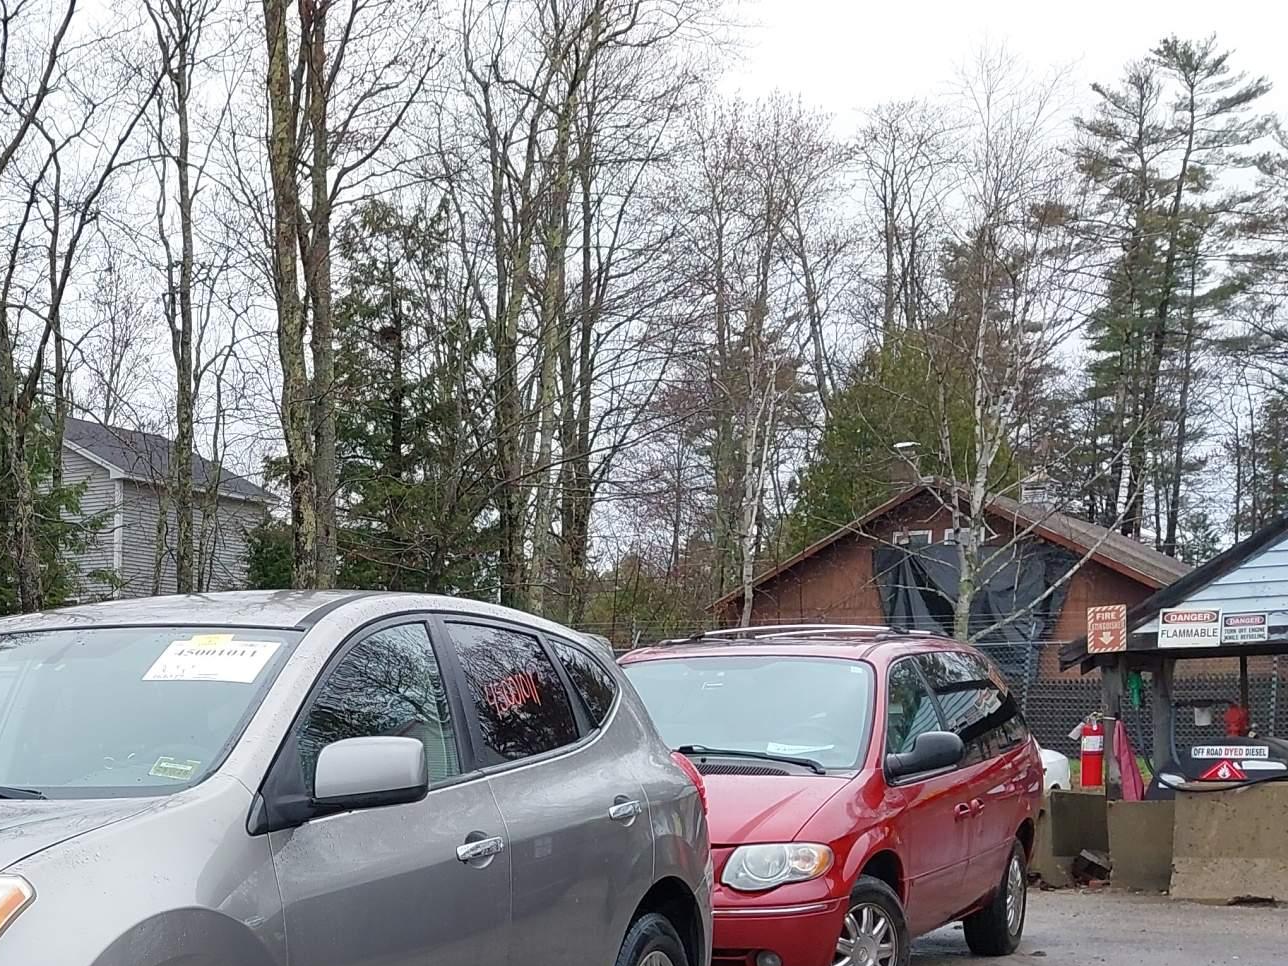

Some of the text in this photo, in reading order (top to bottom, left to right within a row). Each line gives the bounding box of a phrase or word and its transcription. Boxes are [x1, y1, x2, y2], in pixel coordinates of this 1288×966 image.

[1096, 611, 1117, 620] FIRE
[1170, 613, 1210, 621] DANGER
[1229, 616, 1261, 625] DANGER
[1161, 628, 1218, 638] FLAMMABLE
[1193, 748, 1267, 757] OFF ROAD DYED DIESEL
